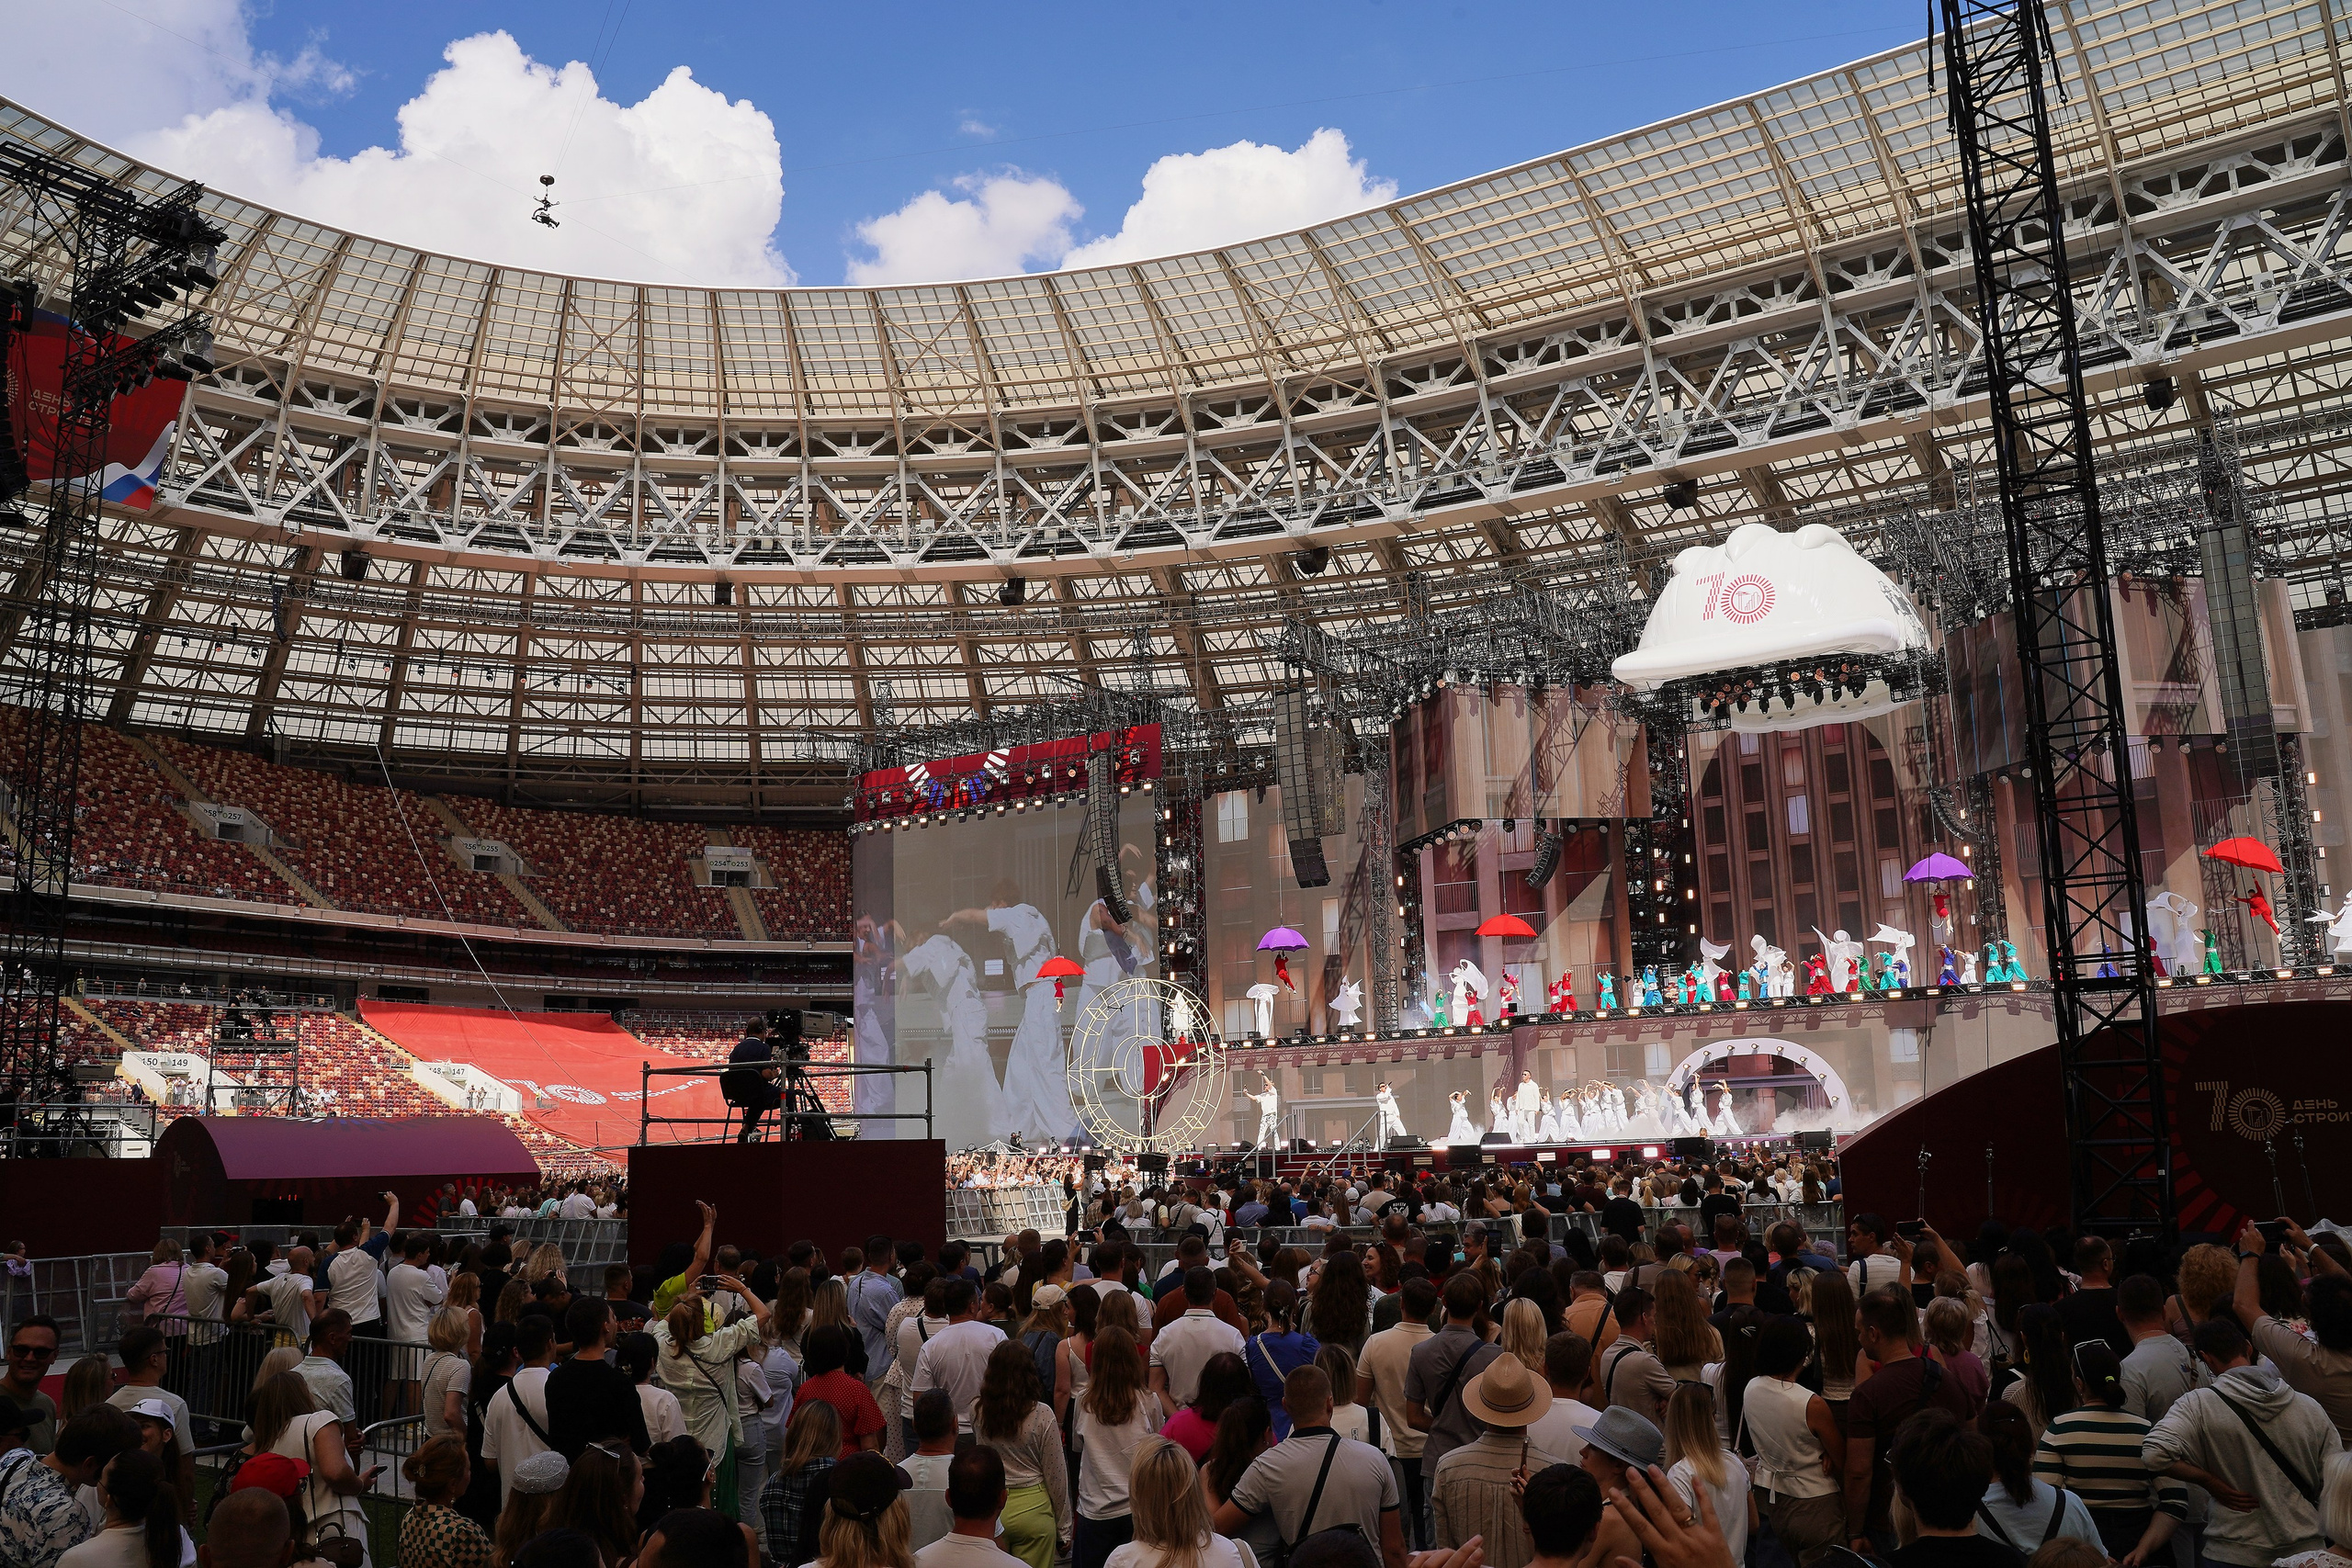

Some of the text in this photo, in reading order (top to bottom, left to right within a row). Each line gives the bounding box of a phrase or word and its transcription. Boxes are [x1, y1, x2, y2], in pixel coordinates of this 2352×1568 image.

[31, 389, 72, 408] ДЕНЬ
[1695, 571, 1777, 625] 70
[228, 813, 242, 821] 257
[172, 1058, 188, 1066] 149
[452, 1067, 465, 1076] 147
[2194, 1080, 2287, 1142] 70
[2292, 1099, 2338, 1111] ДЕНЬ
[2294, 1111, 2352, 1124] СТРОИ
